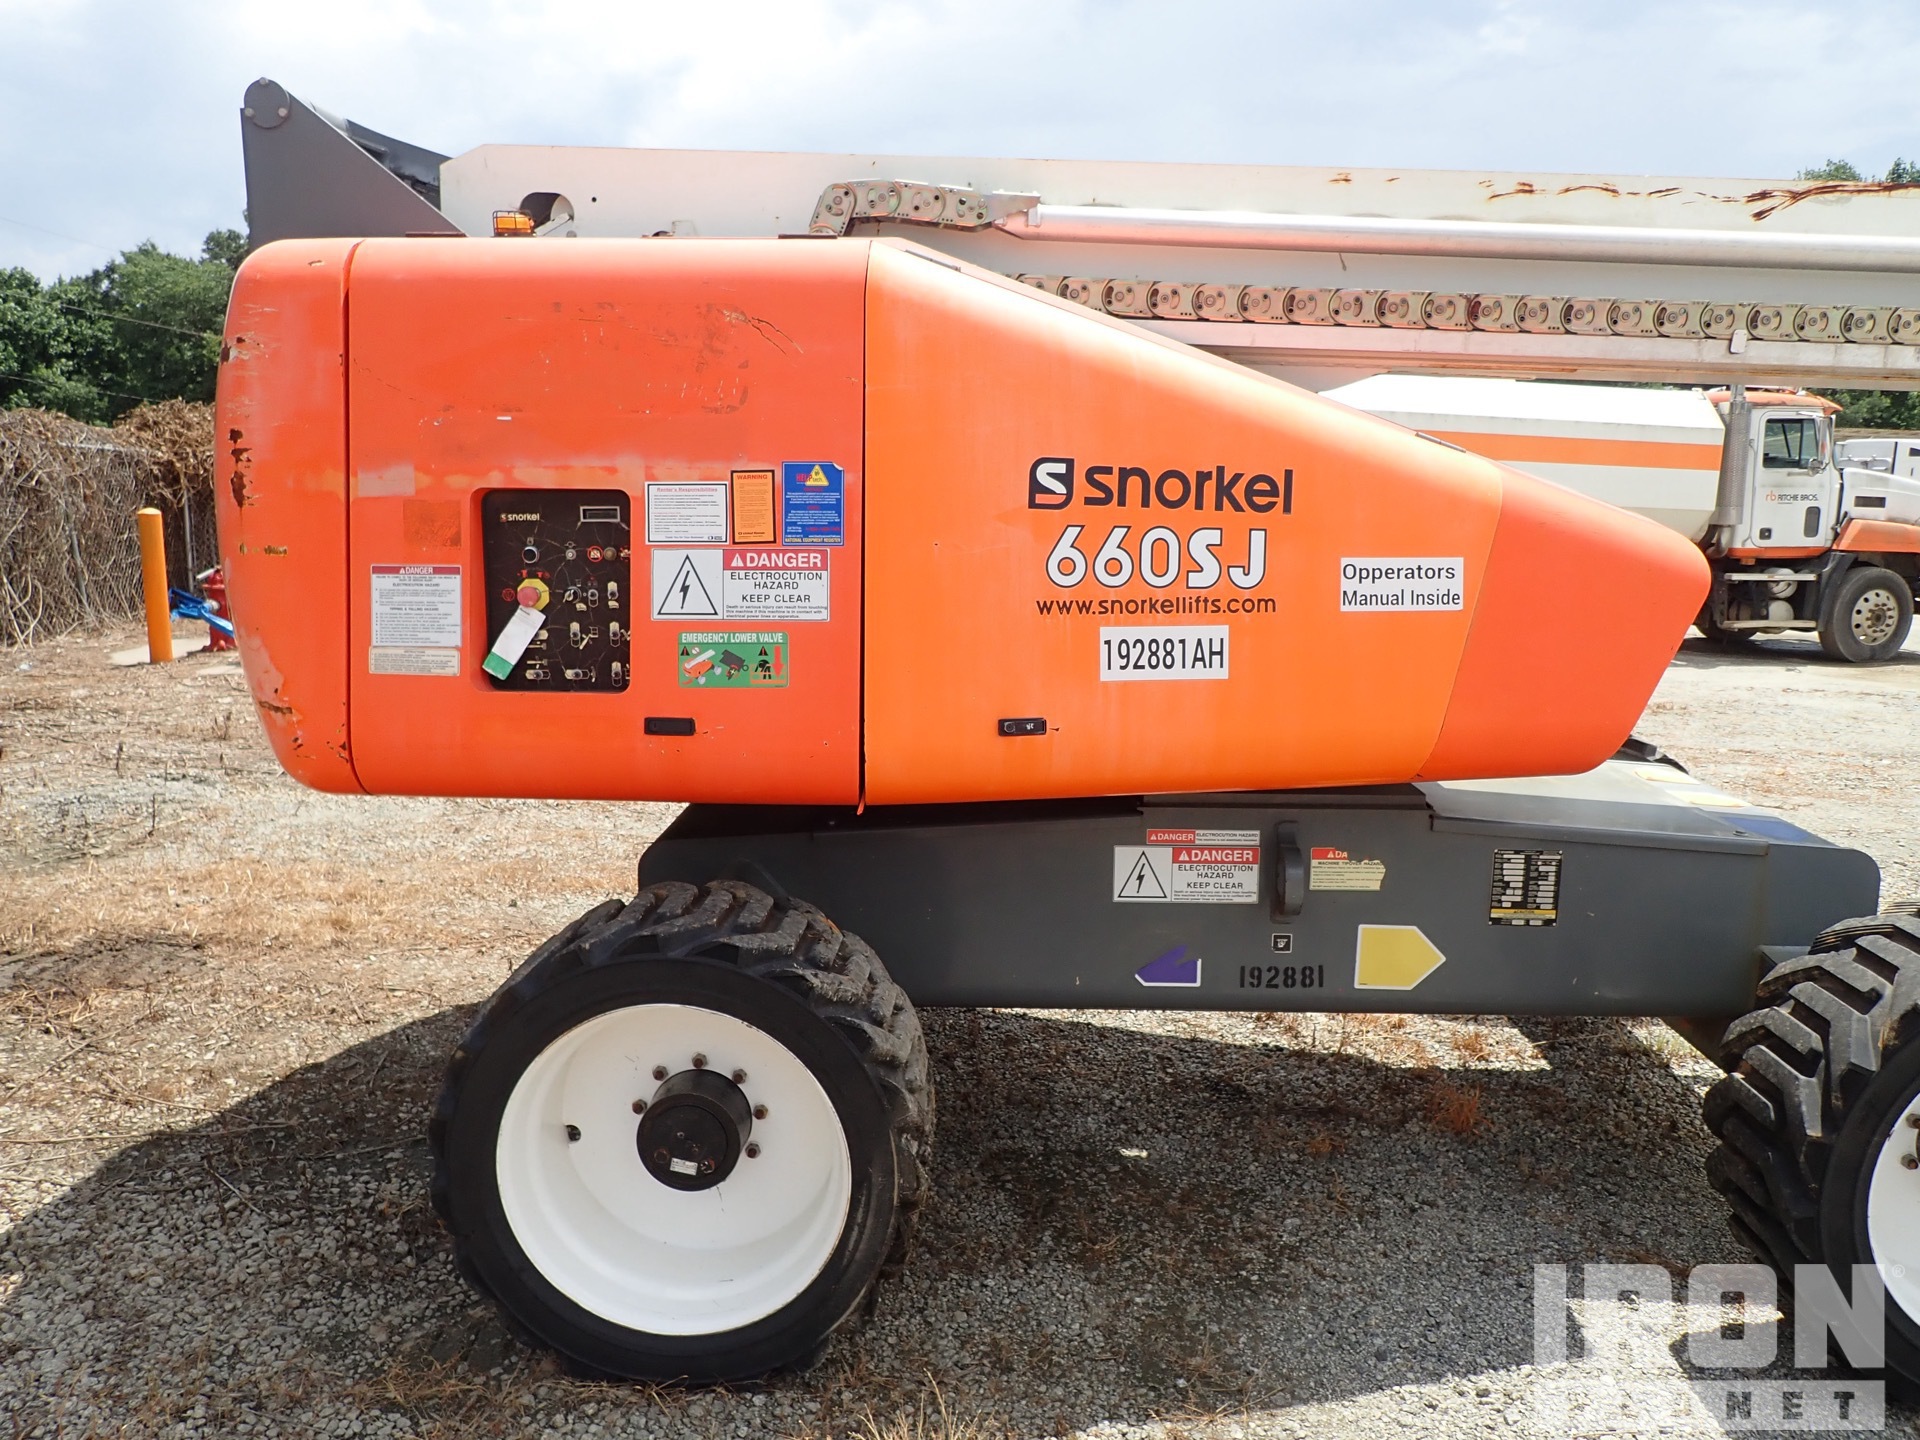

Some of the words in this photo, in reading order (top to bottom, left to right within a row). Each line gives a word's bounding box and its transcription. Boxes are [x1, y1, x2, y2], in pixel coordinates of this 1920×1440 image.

[1084, 466, 1292, 514] snorkel
[508, 513, 540, 521] snorkel
[747, 552, 822, 567] DANGER
[1046, 525, 1268, 590] 660SJ
[730, 572, 822, 580] ELECTROCUTION
[1342, 563, 1455, 584] Opperators
[742, 594, 770, 602] KEEP
[774, 594, 811, 602] CLEAR
[1036, 594, 1276, 615] www.snorkellifts.com
[1342, 589, 1405, 607] Manual
[1411, 588, 1460, 606] Inside
[682, 633, 729, 642] EMERGENCY
[731, 633, 757, 642] LOWER
[758, 633, 783, 642] VALVE
[1103, 638, 1224, 670] 192881AH
[1191, 851, 1253, 861] DANGER
[1239, 965, 1324, 989] 192881
